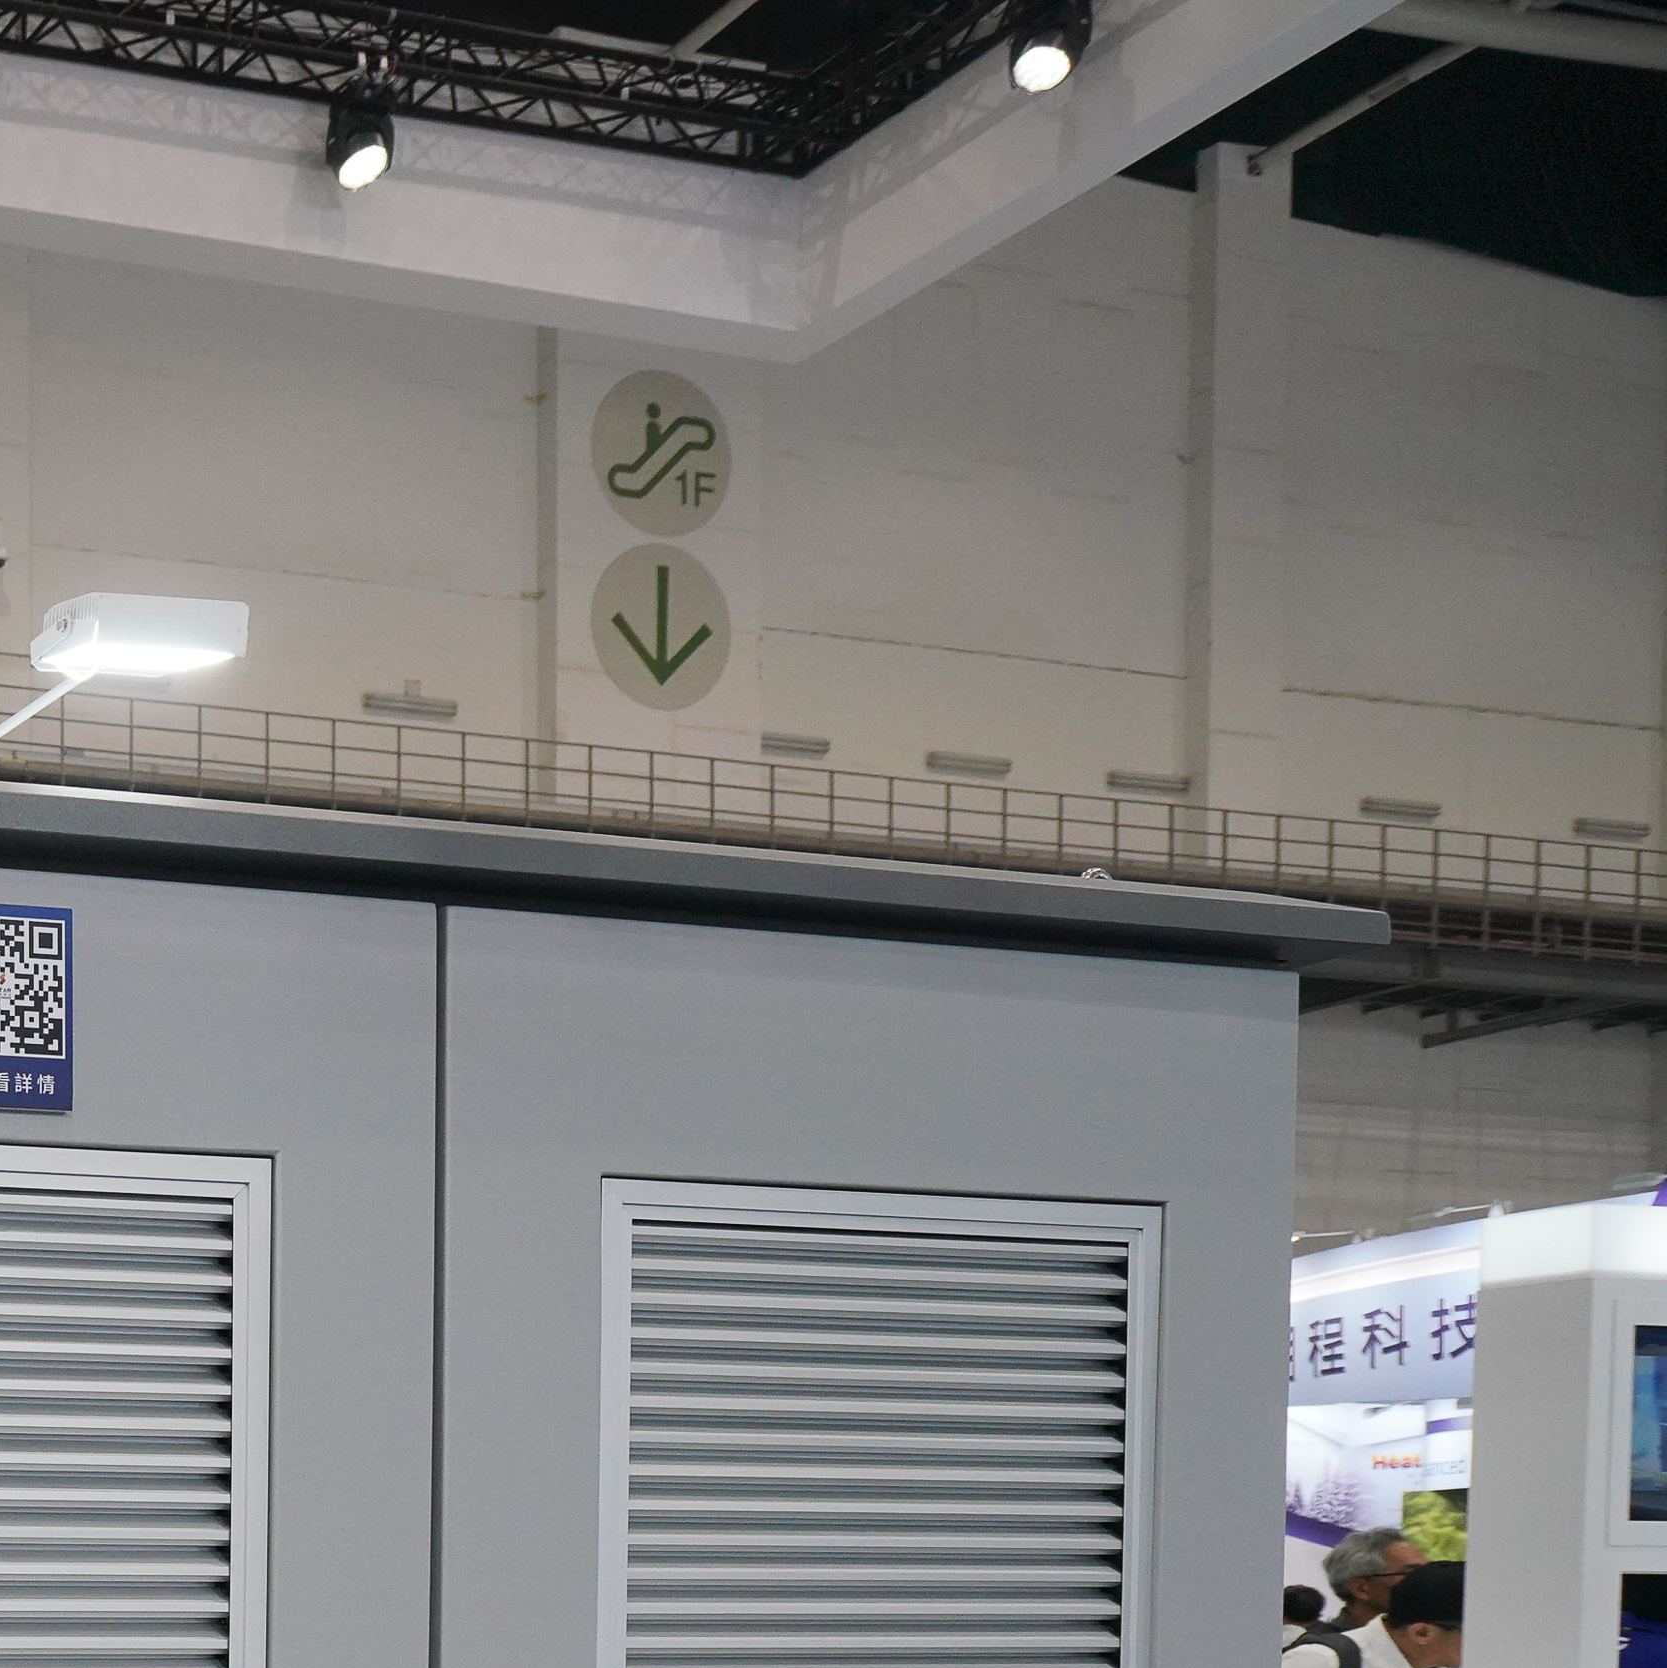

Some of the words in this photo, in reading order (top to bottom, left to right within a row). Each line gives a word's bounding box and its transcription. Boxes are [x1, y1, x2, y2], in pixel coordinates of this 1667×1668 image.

[675, 469, 717, 507] 1F
[1289, 1294, 1477, 1382] 程科技
[1372, 1453, 1423, 1470] Heat
